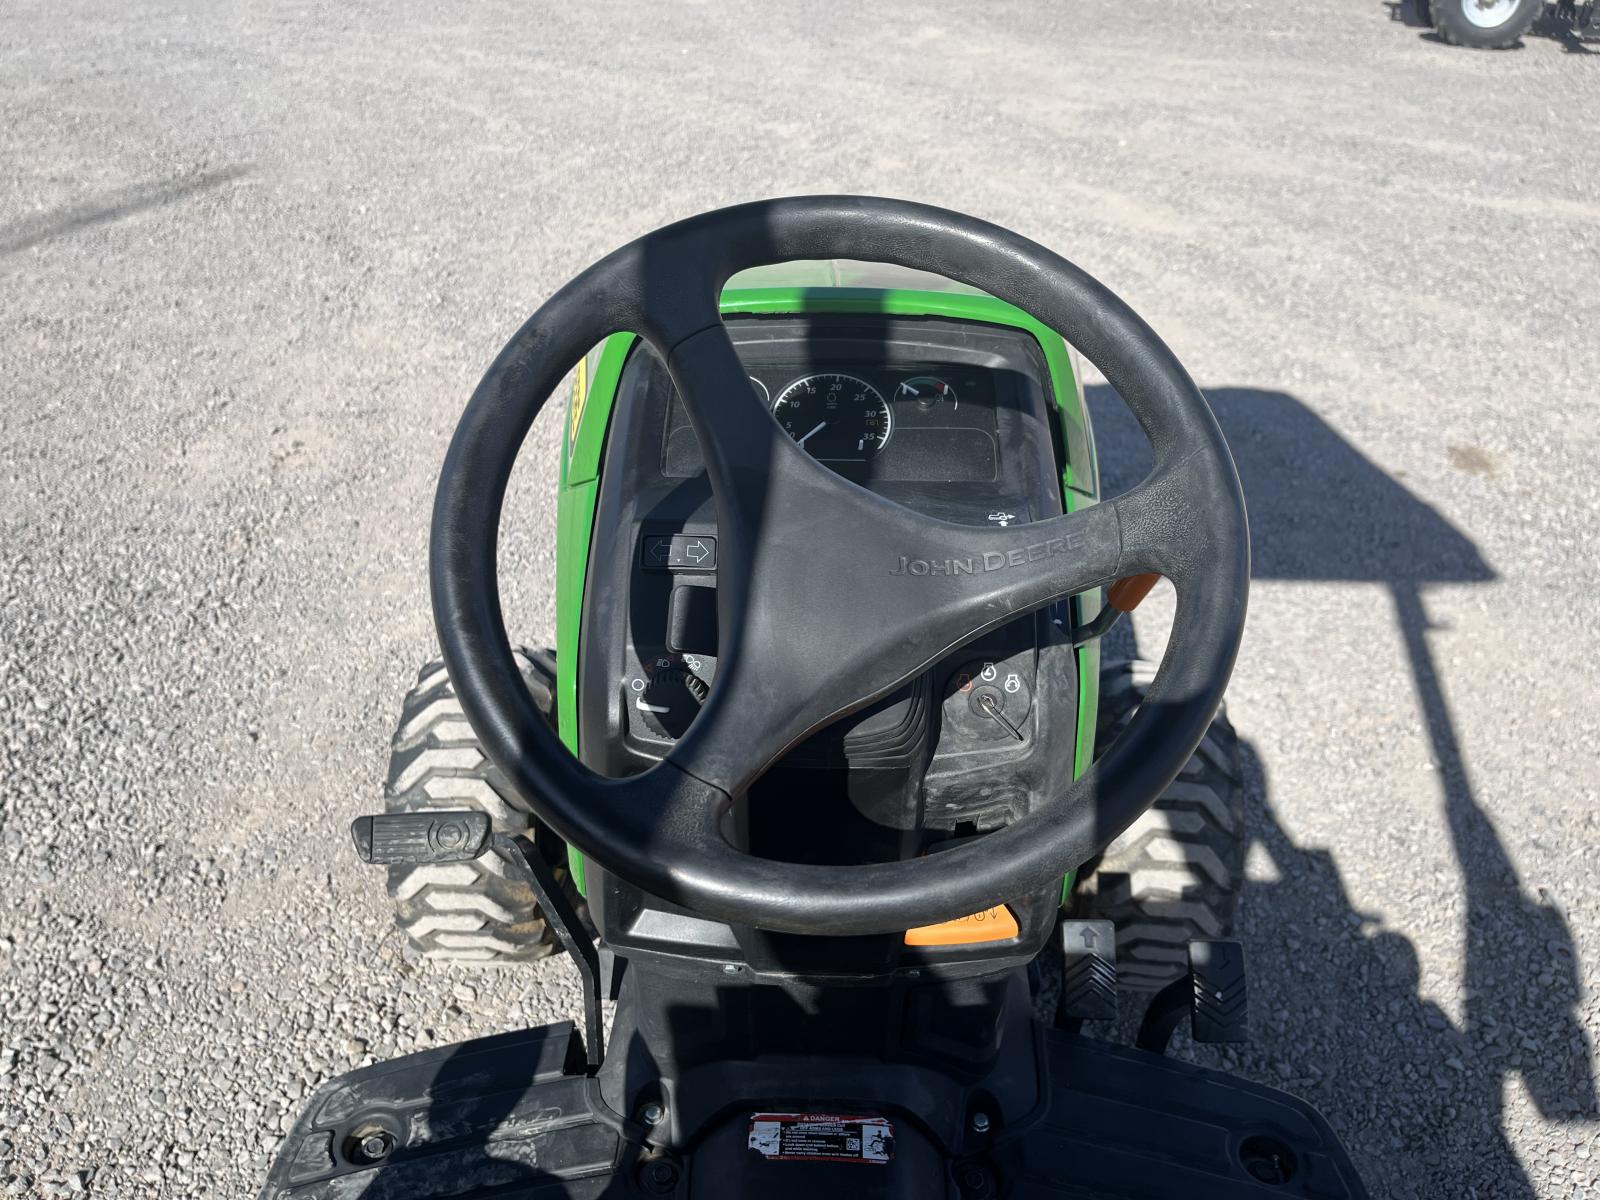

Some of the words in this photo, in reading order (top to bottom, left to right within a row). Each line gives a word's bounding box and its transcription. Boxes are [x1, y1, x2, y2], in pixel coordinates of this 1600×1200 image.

[829, 383, 842, 391] 20
[853, 393, 865, 401] 25
[864, 410, 877, 418] 30
[785, 421, 793, 429] 5
[863, 432, 875, 441] 35
[889, 556, 974, 576] JOHN
[982, 532, 1085, 573] DEERE
